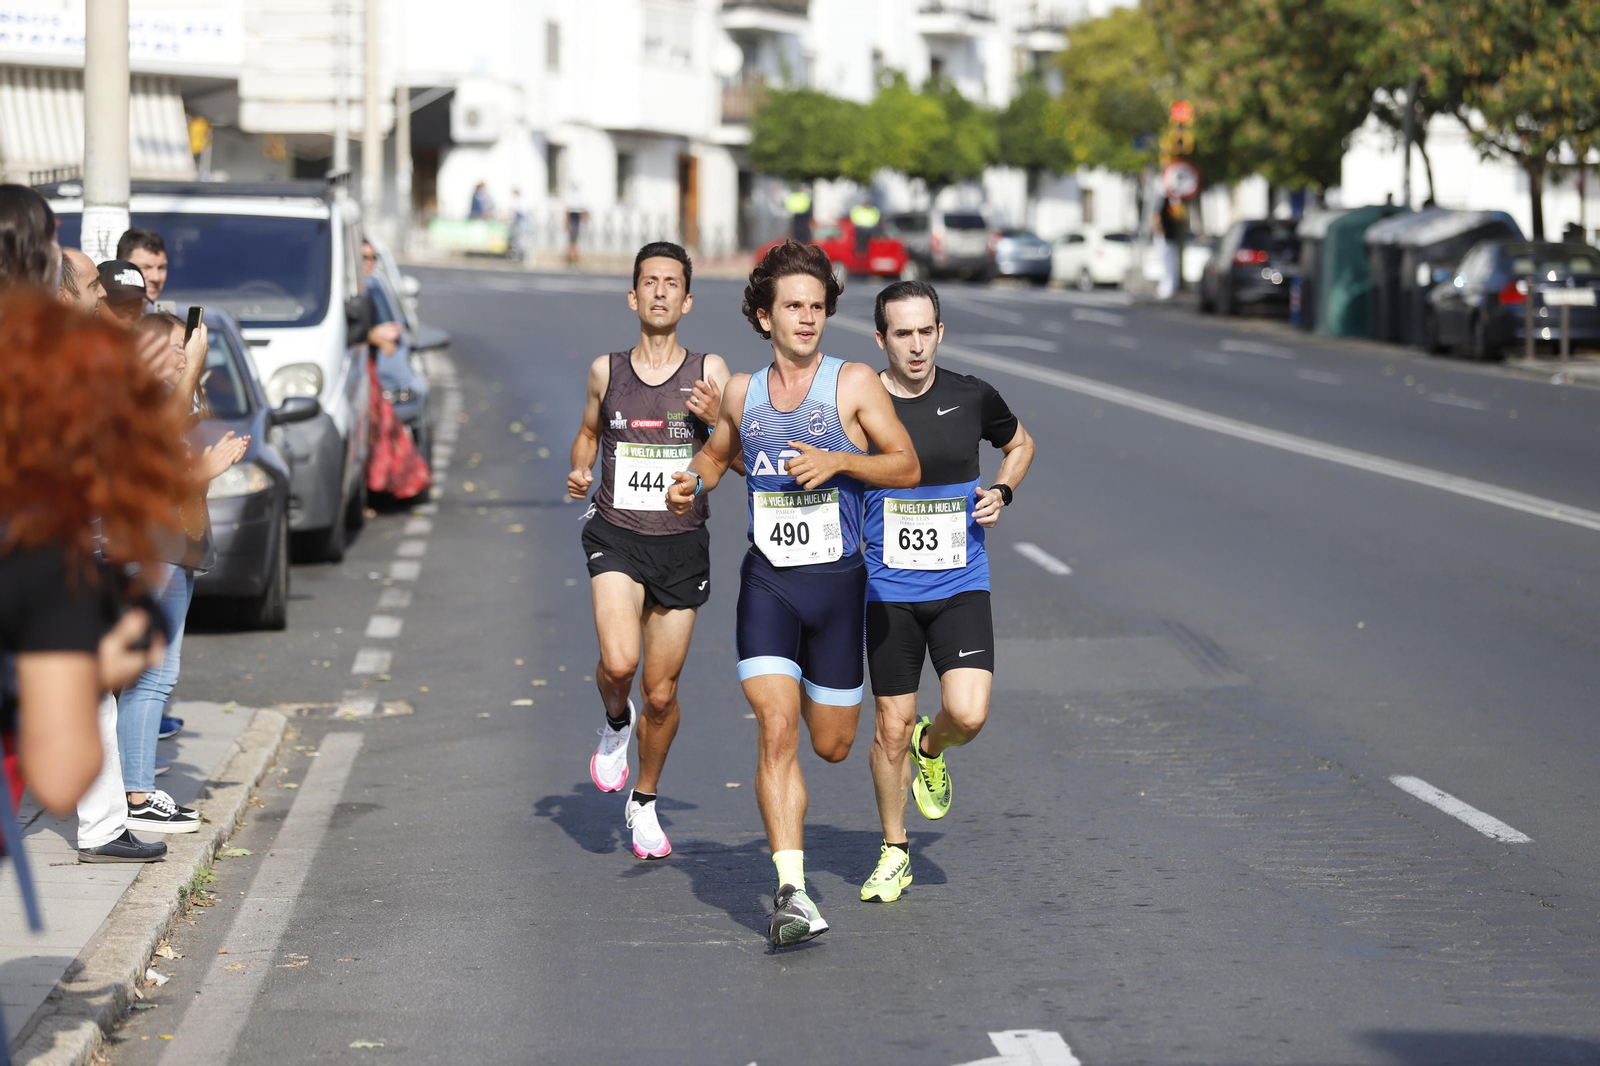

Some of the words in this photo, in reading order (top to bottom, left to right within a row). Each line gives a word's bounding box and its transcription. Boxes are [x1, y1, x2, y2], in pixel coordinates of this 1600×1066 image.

[668, 427, 695, 438] TEAM
[630, 447, 655, 458] VUELTA
[656, 449, 662, 458] A
[663, 448, 687, 458] HUELVA
[628, 471, 665, 492] 444
[760, 496, 768, 506] 34
[768, 495, 795, 507] VUELTA
[796, 495, 803, 506] A
[804, 493, 832, 504] HUELVA
[889, 502, 898, 512] 34
[899, 503, 926, 514] VUELTA
[927, 502, 934, 513] A
[935, 501, 961, 512] HUELVA
[769, 521, 810, 546] 490
[898, 527, 939, 551] 633
